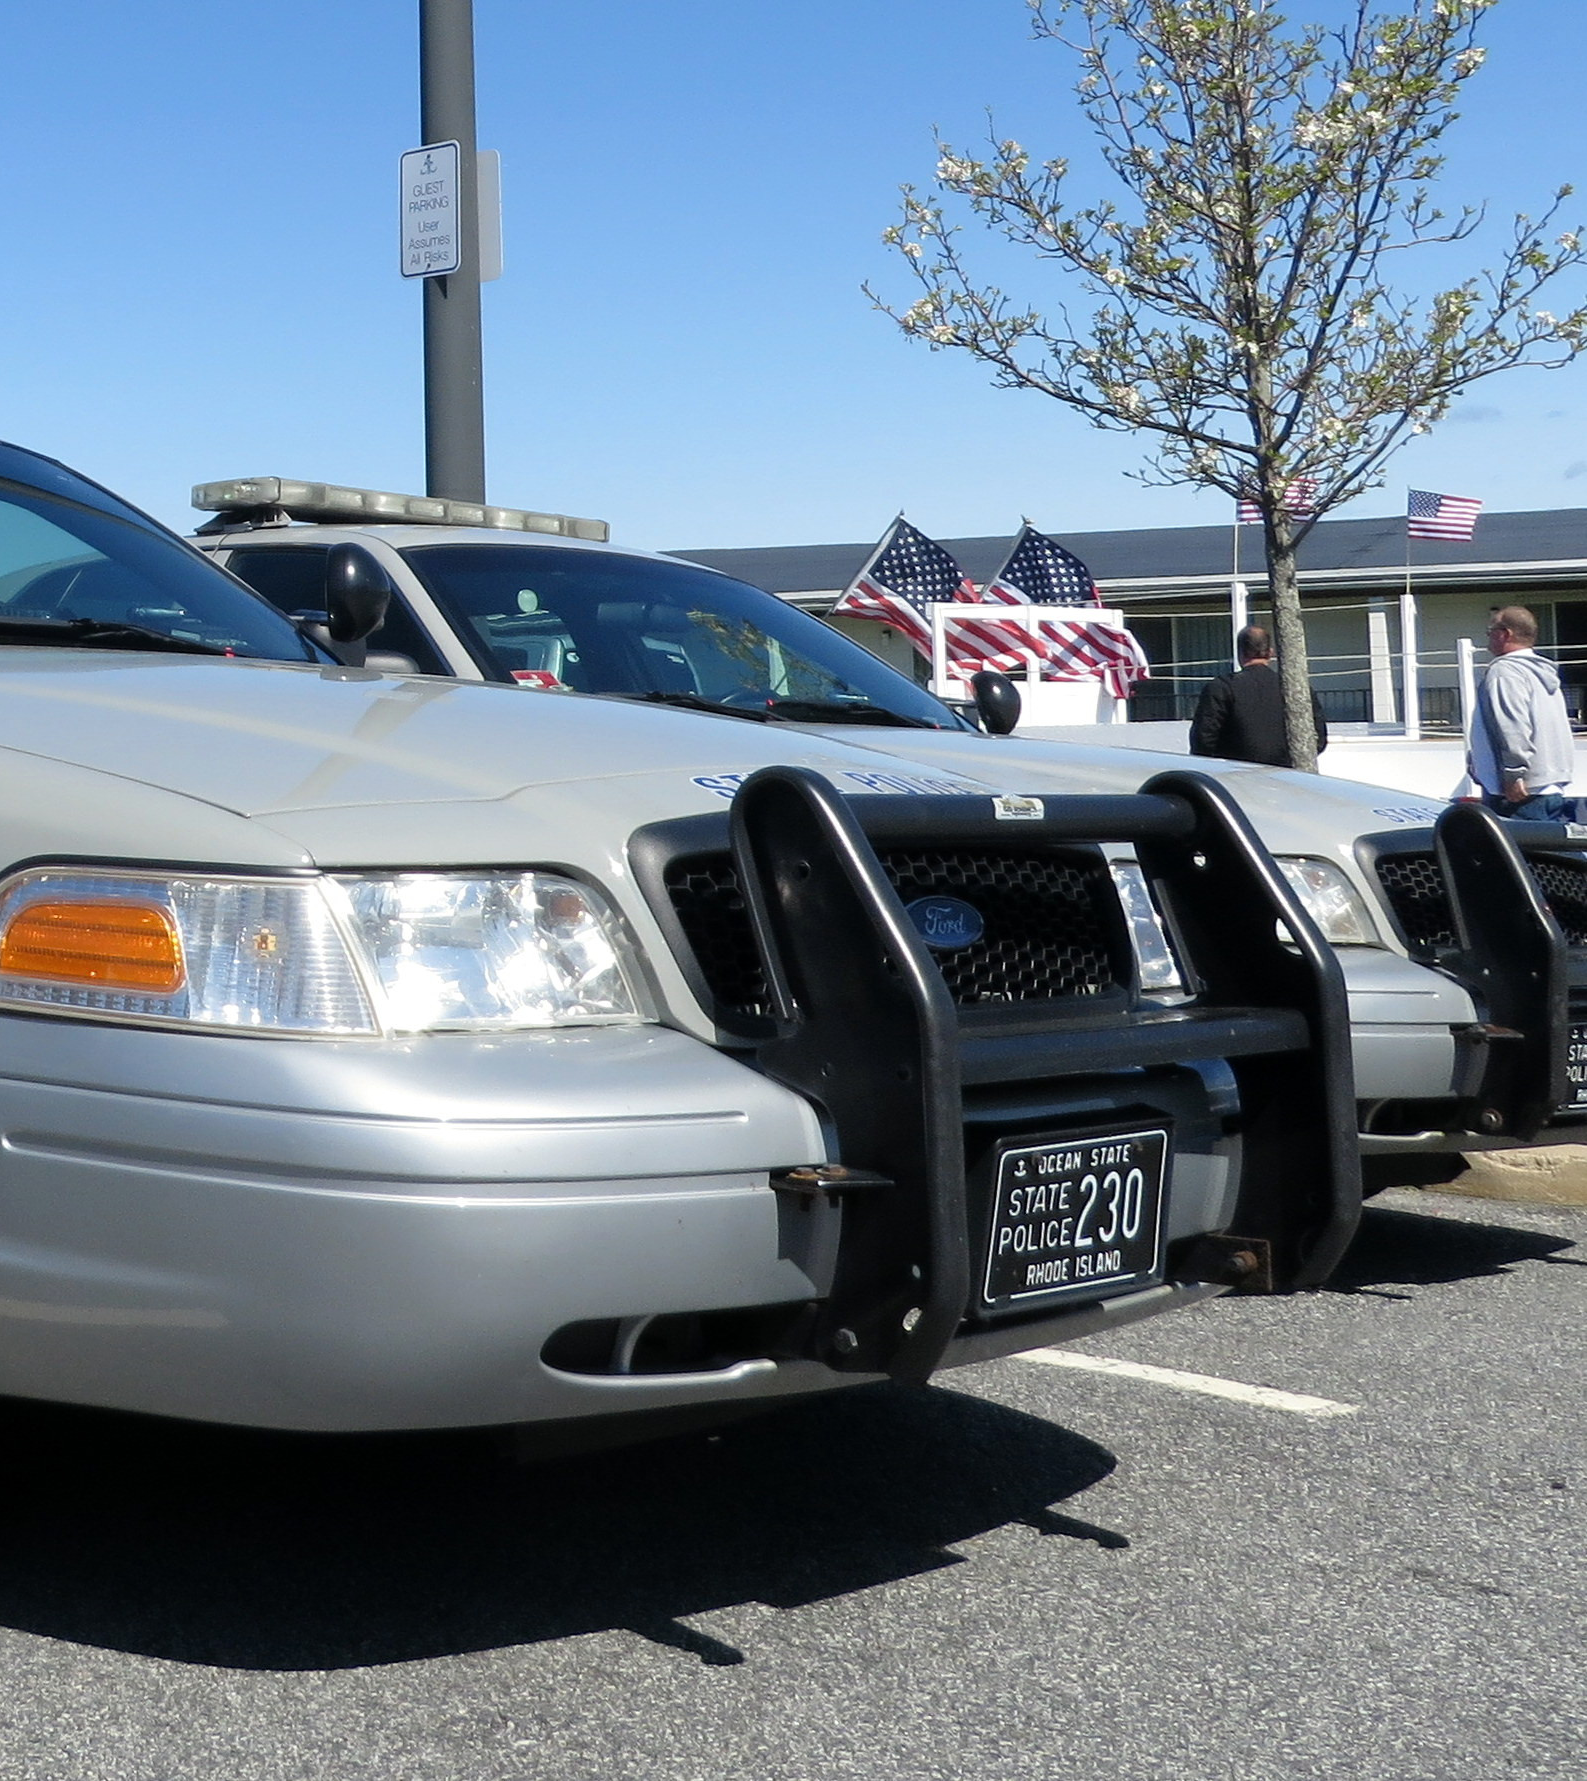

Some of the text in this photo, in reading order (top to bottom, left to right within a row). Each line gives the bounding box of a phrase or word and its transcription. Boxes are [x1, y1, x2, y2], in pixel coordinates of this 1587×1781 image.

[413, 180, 445, 197] GUEST
[408, 195, 449, 214] PARKING
[418, 220, 439, 233] User
[408, 234, 451, 250] Assumes
[411, 250, 450, 266] All Risks
[925, 905, 965, 935] Ford
[1038, 1144, 1131, 1174] OCEAN STATE
[1008, 1181, 1073, 1217] STATE
[1074, 1167, 1143, 1247] 230
[998, 1217, 1073, 1255] POLICE
[1026, 1250, 1121, 1286] RHODE ISLAND
